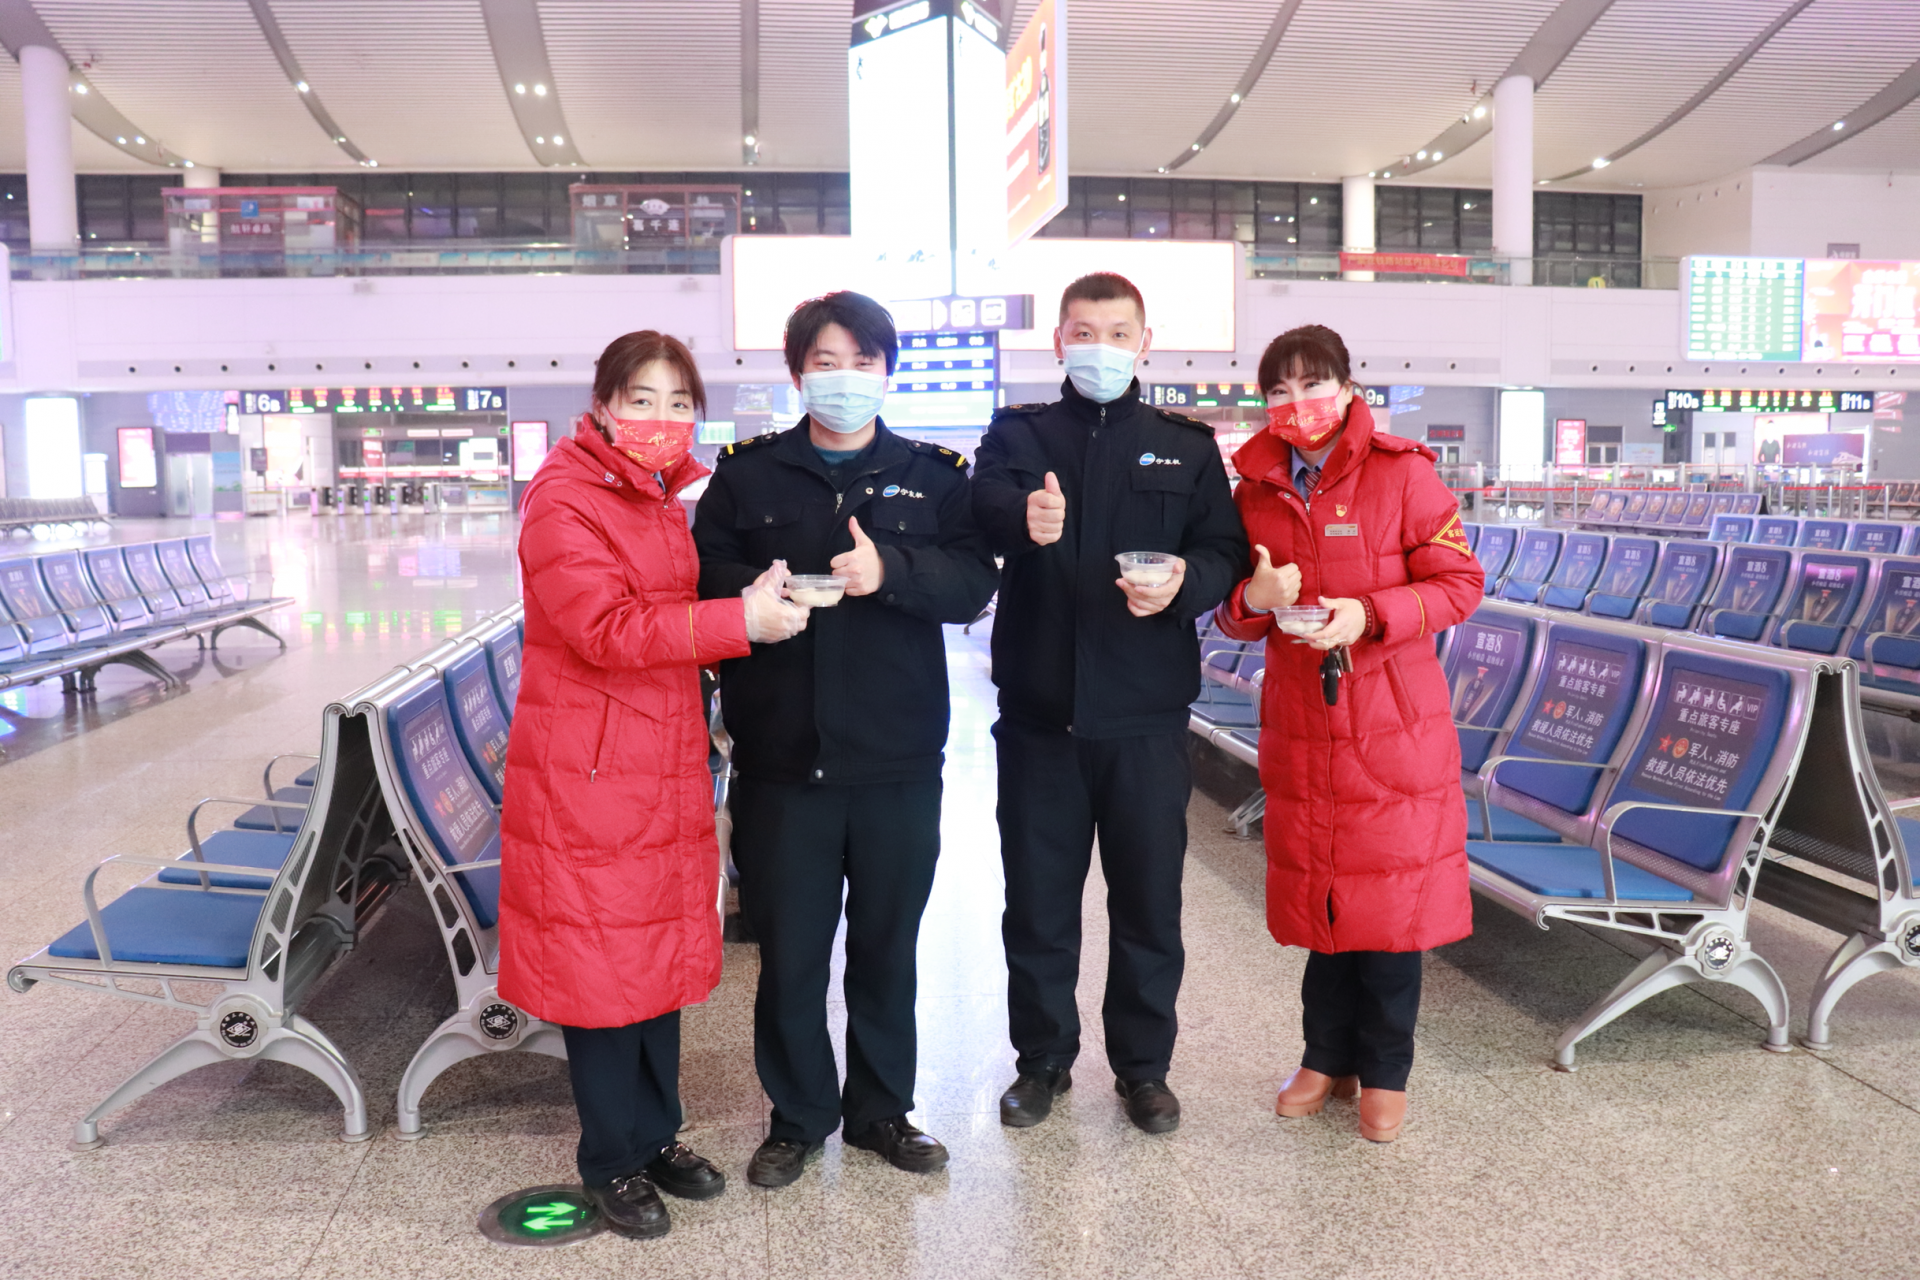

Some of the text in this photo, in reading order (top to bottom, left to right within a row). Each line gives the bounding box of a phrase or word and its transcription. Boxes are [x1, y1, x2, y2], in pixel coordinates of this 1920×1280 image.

[257, 393, 281, 412] 6B
[479, 390, 502, 408] 7B
[1166, 387, 1187, 405] 8B
[1366, 389, 1385, 406] 9B
[1676, 392, 1699, 409] 10B
[1849, 393, 1871, 410] 11B
[1475, 631, 1503, 654] 宣酒8
[1611, 669, 1621, 678] VIP
[1558, 674, 1607, 698] 重点旅客专座
[1565, 704, 1604, 727] 军人、消防
[1746, 703, 1759, 714] VIP
[1677, 707, 1742, 736] 重点旅客专座
[1531, 718, 1594, 749] 救援人员依法优先
[421, 746, 450, 780] 重点旅客专座
[1688, 742, 1740, 769] 军人、消防
[1645, 757, 1728, 794] 救援人员依法优先
